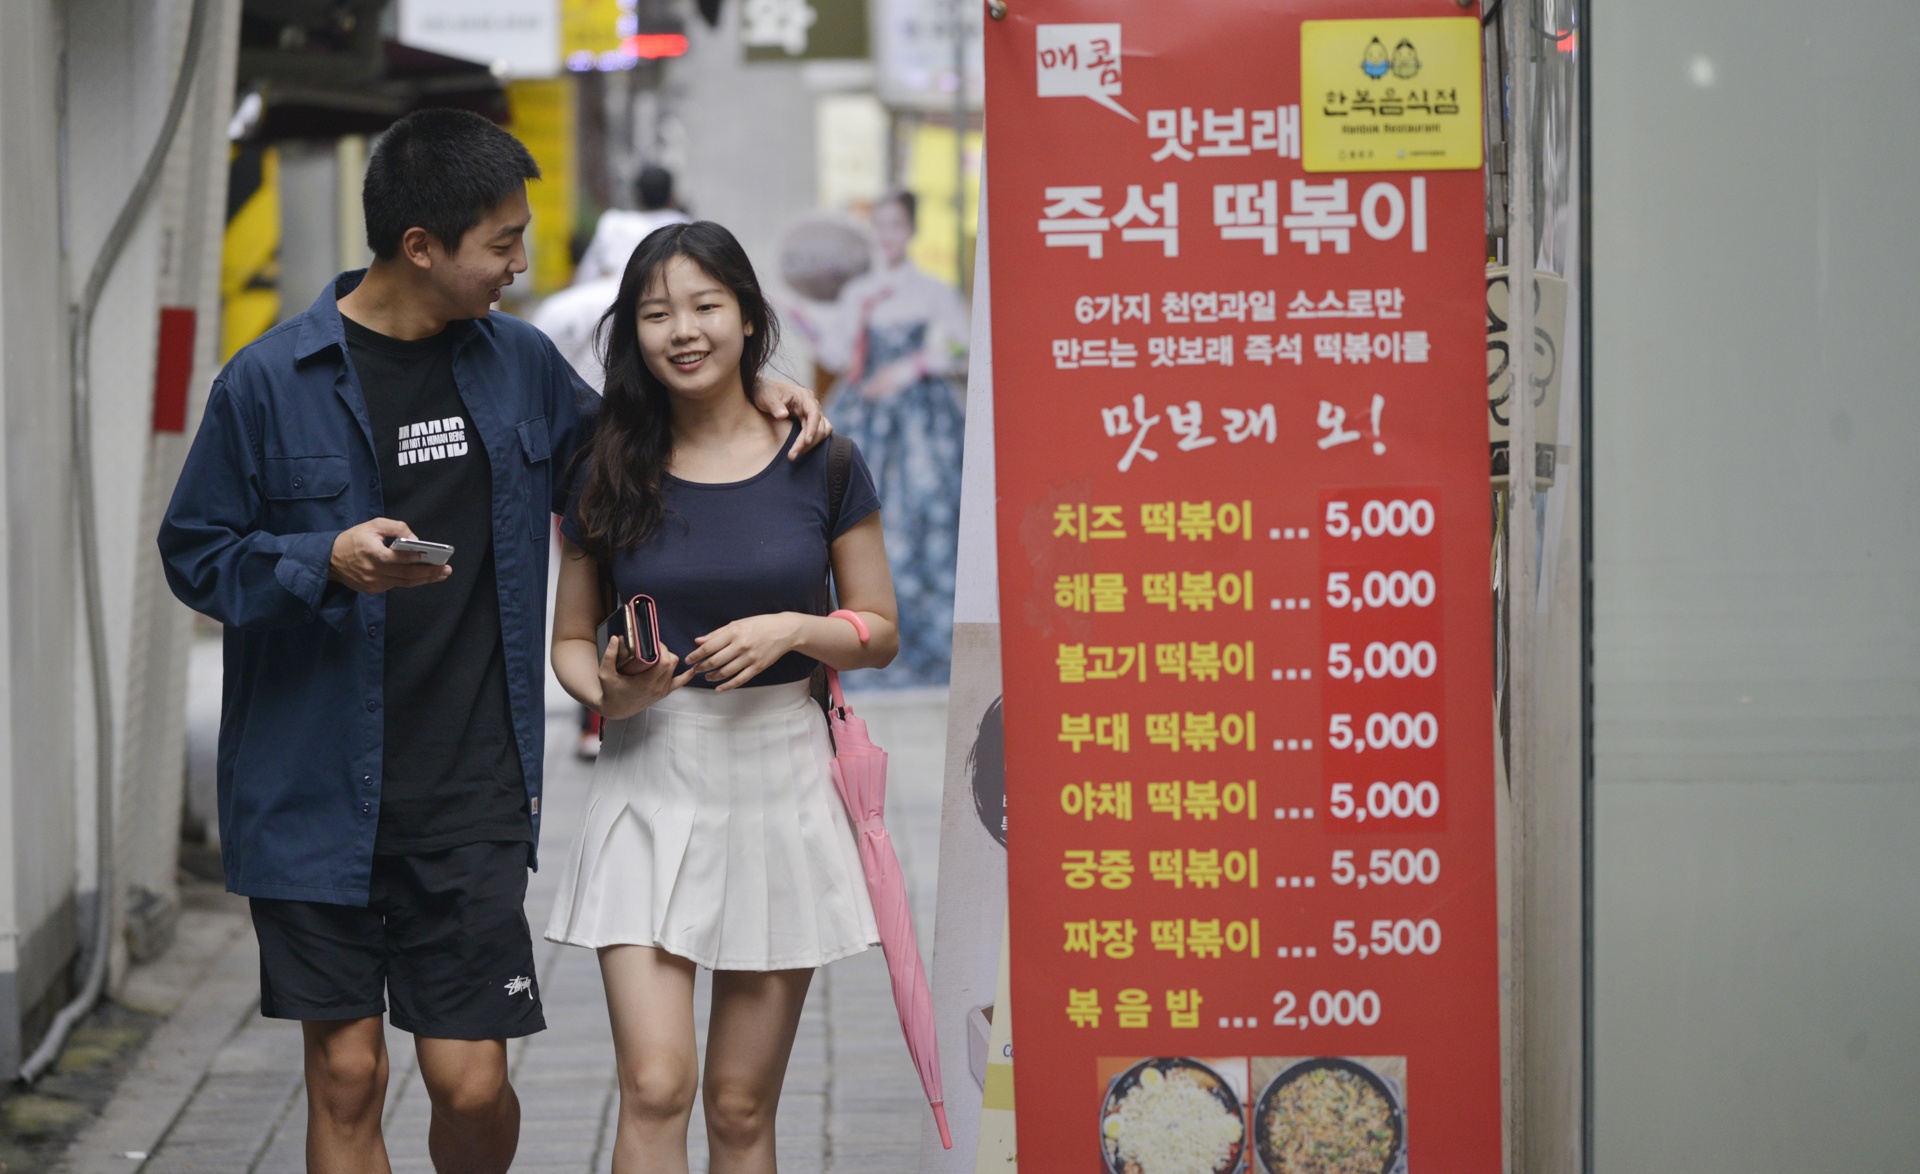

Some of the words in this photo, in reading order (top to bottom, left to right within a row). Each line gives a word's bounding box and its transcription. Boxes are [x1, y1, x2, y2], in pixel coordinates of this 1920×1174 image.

[1040, 38, 1121, 87] 매콤
[1323, 87, 1459, 117] 한복음식점
[1147, 105, 1300, 162] 맛보래
[1038, 182, 1178, 259] 즉석
[1213, 177, 1427, 255] 떡볶이
[1075, 293, 1150, 325] 6가지
[1162, 290, 1276, 323] 천연과일
[1287, 288, 1404, 319] 소스로만
[1053, 337, 1138, 369] 만드는
[1148, 335, 1233, 367] 맛보래
[1244, 334, 1302, 365] 즉석
[1314, 331, 1430, 364] 떡볶이를
[409, 437, 421, 449] NOT
[426, 432, 449, 446] HUMAN
[448, 430, 466, 443] BEING
[1101, 394, 1277, 472] 맛보래
[1053, 503, 1126, 543] 치즈
[1141, 500, 1252, 541] 떡볶이
[1326, 500, 1434, 540] 5,000
[1054, 573, 1128, 613] 해물
[1142, 570, 1253, 612] 떡볶이
[1327, 571, 1435, 611] 5,000
[1056, 643, 1146, 682] 불고기
[1156, 641, 1254, 681] 떡볶이
[1328, 641, 1436, 682] 5,000
[1058, 713, 1129, 752] 부대
[1146, 711, 1255, 752] 떡볶이
[1329, 712, 1438, 753] 5,000
[1061, 781, 1132, 821] 야채
[1148, 780, 1256, 820] 떡볶이
[1331, 782, 1439, 822] 5,000
[1062, 850, 1134, 889] 궁중
[1149, 848, 1258, 888] 떡볶이
[1332, 849, 1440, 888] 5,500
[1064, 919, 1137, 958] 짜장
[1151, 919, 1259, 958] 떡볶이
[1333, 919, 1441, 959] 5,500
[1274, 990, 1380, 1029] 2,000
